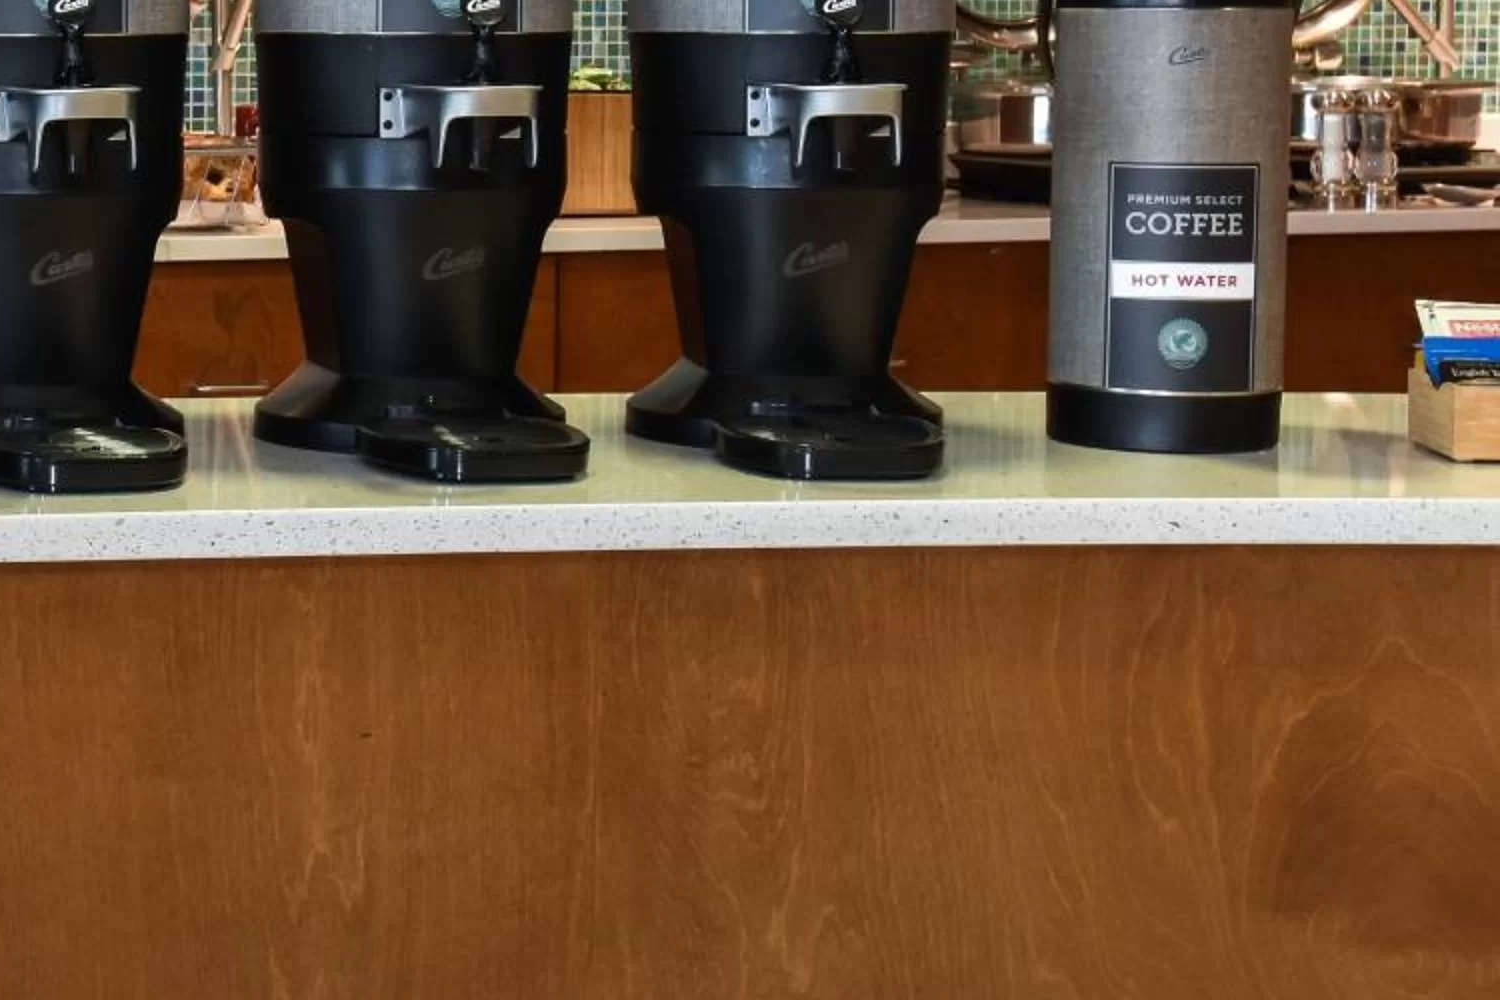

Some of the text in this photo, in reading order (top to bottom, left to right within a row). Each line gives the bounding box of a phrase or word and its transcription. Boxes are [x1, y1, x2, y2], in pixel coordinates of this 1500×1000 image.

[1127, 194, 1243, 205] PREMIUM SELECT
[1125, 211, 1243, 236] COFFEE
[1131, 275, 1237, 287] HOT WATER
